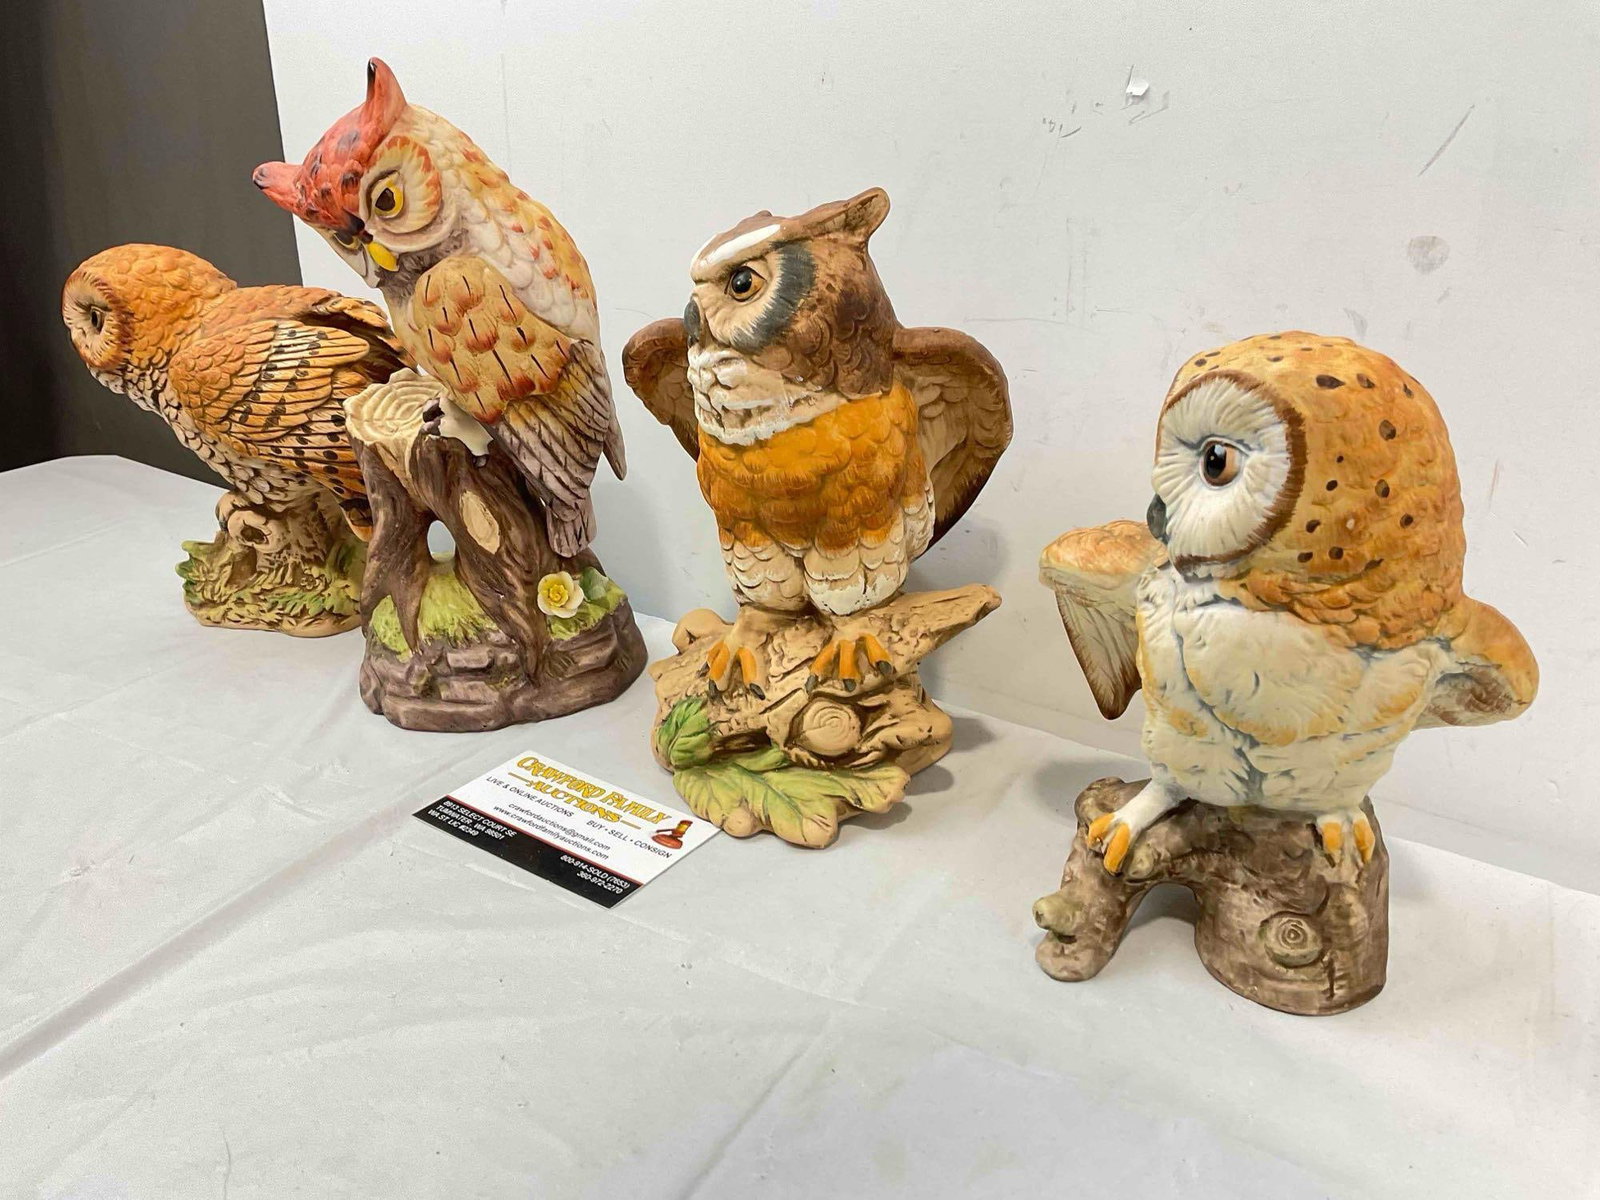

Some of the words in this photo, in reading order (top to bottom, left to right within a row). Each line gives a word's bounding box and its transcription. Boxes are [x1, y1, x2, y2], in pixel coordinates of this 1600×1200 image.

[486, 776, 504, 786] LIVE
[510, 786, 537, 800] ONLINE
[535, 798, 574, 817] AUCTIONS
[428, 809, 439, 817] WA
[448, 820, 461, 828] LIC
[458, 807, 484, 822] SELECT
[482, 819, 508, 832] COURT
[474, 822, 486, 832] WA
[508, 803, 611, 850] crawfordauctions@gmail.com
[493, 806, 609, 860] www.crawfordfamilyauctions.com
[586, 820, 606, 829] BUY
[608, 828, 628, 841] SELL
[634, 840, 672, 858] CONSIGN
[560, 854, 608, 879] 800-914-SOLD
[576, 870, 623, 894] 360-972-2270
